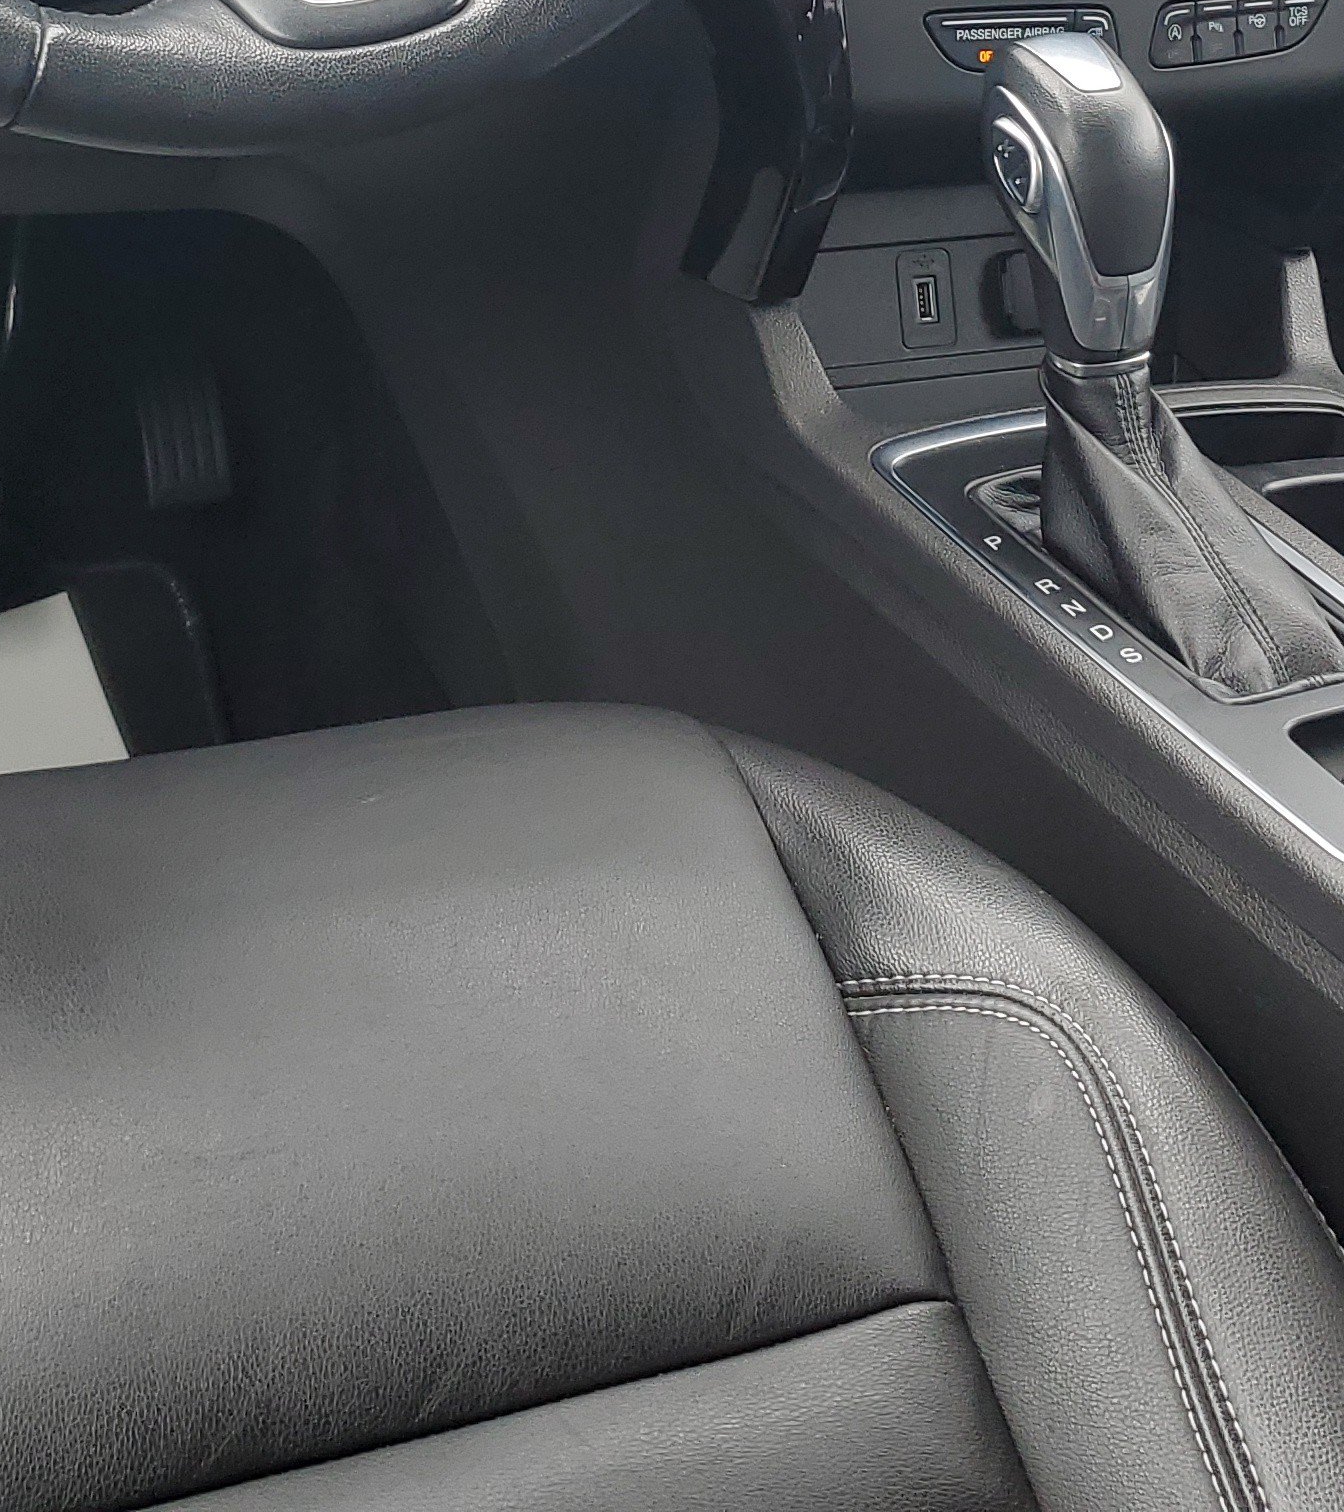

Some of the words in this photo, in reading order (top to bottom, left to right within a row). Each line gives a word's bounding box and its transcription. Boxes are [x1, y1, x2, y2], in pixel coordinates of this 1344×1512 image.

[1288, 5, 1308, 17] TCS
[1287, 16, 1308, 27] OFF
[956, 28, 1023, 41] PASSENGER
[983, 534, 1002, 551] P
[1034, 577, 1061, 595] R
[1060, 598, 1087, 618] N
[1089, 624, 1114, 642] D
[1119, 646, 1144, 664] S
